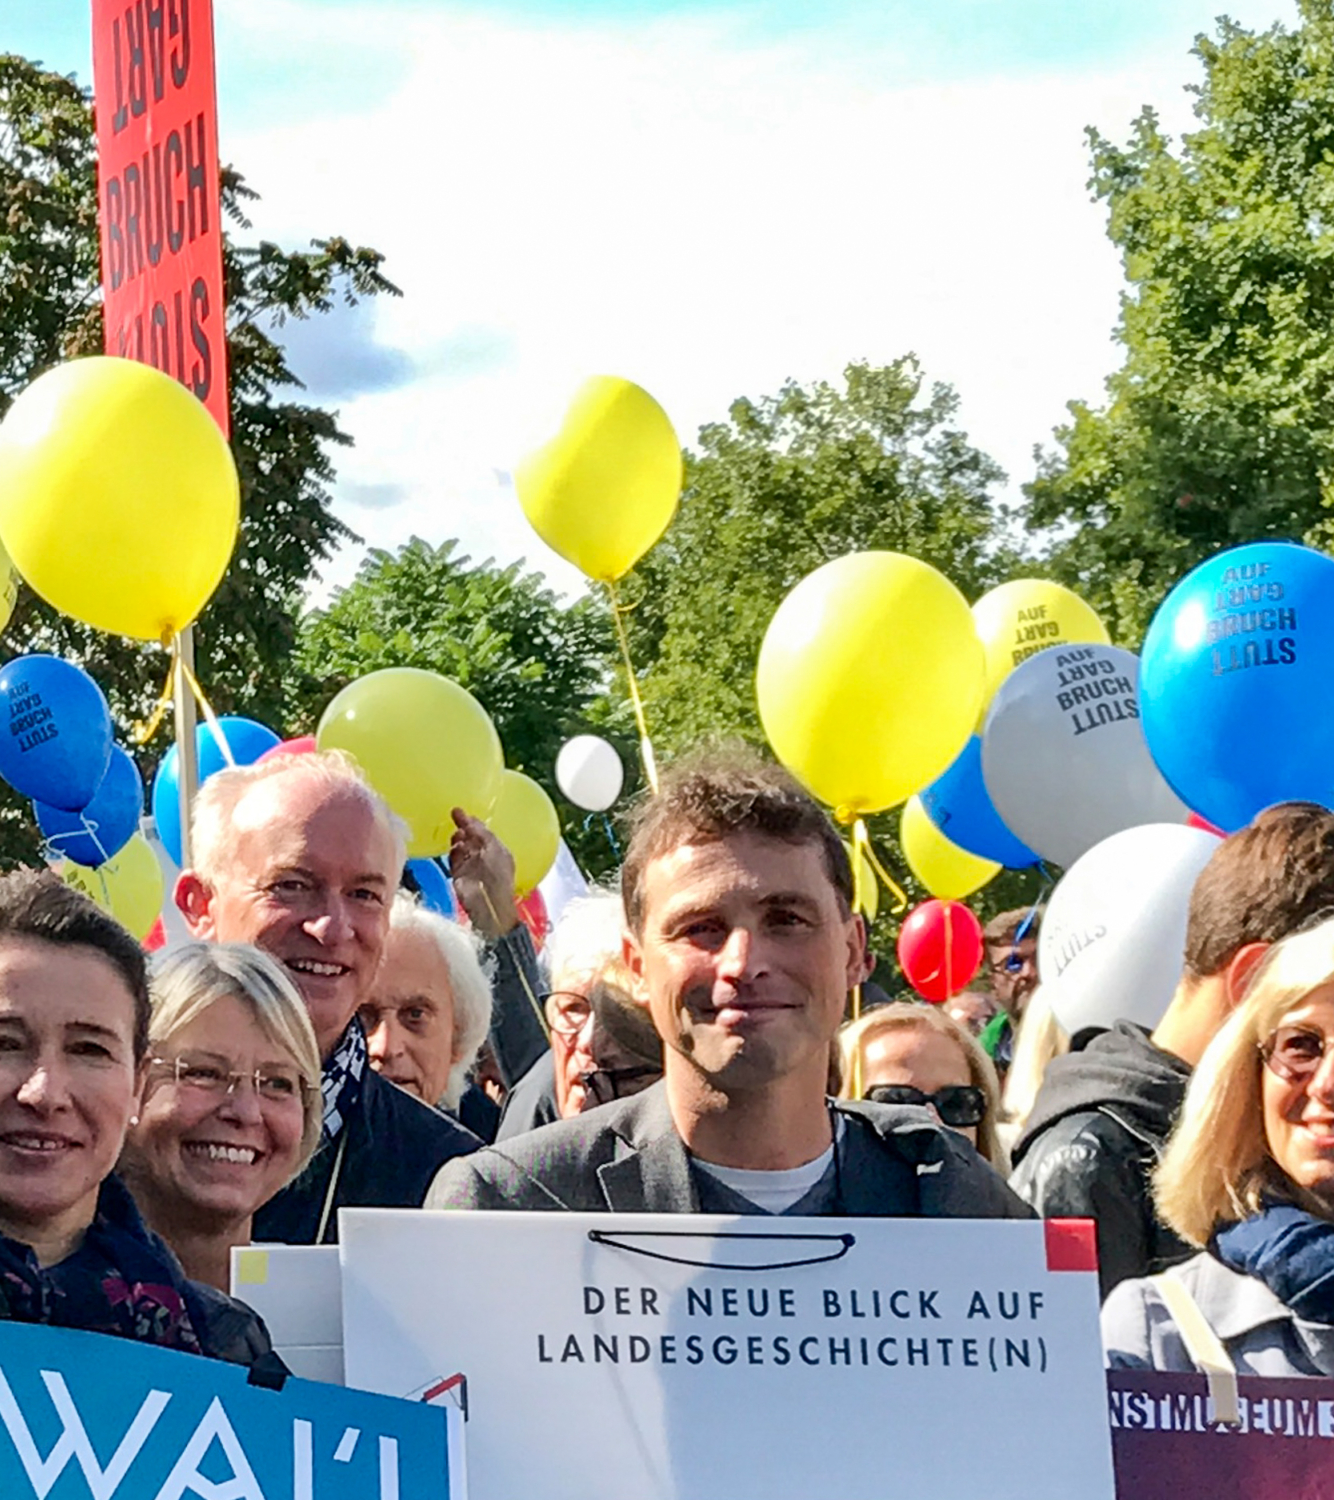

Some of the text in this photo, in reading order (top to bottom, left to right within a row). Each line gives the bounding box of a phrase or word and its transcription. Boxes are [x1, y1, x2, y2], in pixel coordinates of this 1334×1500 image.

[106, 112, 209, 293] BRUCH
[1223, 562, 1271, 584] AUF
[1017, 605, 1048, 623] AUF
[1214, 582, 1285, 613] GART
[1015, 621, 1060, 644] GART
[1206, 607, 1298, 645] BRUCH
[1056, 649, 1097, 668] AUF
[1057, 659, 1115, 688] GART
[1211, 637, 1297, 677] STUTT
[1056, 676, 1134, 712] BRUCH
[1071, 698, 1139, 736] STUTT
[19, 723, 59, 752] STUTT
[582, 1286, 1046, 1322] DER NEUE BLICK AUF
[537, 1334, 1049, 1373] LANDESGESCHICHTE(N)
